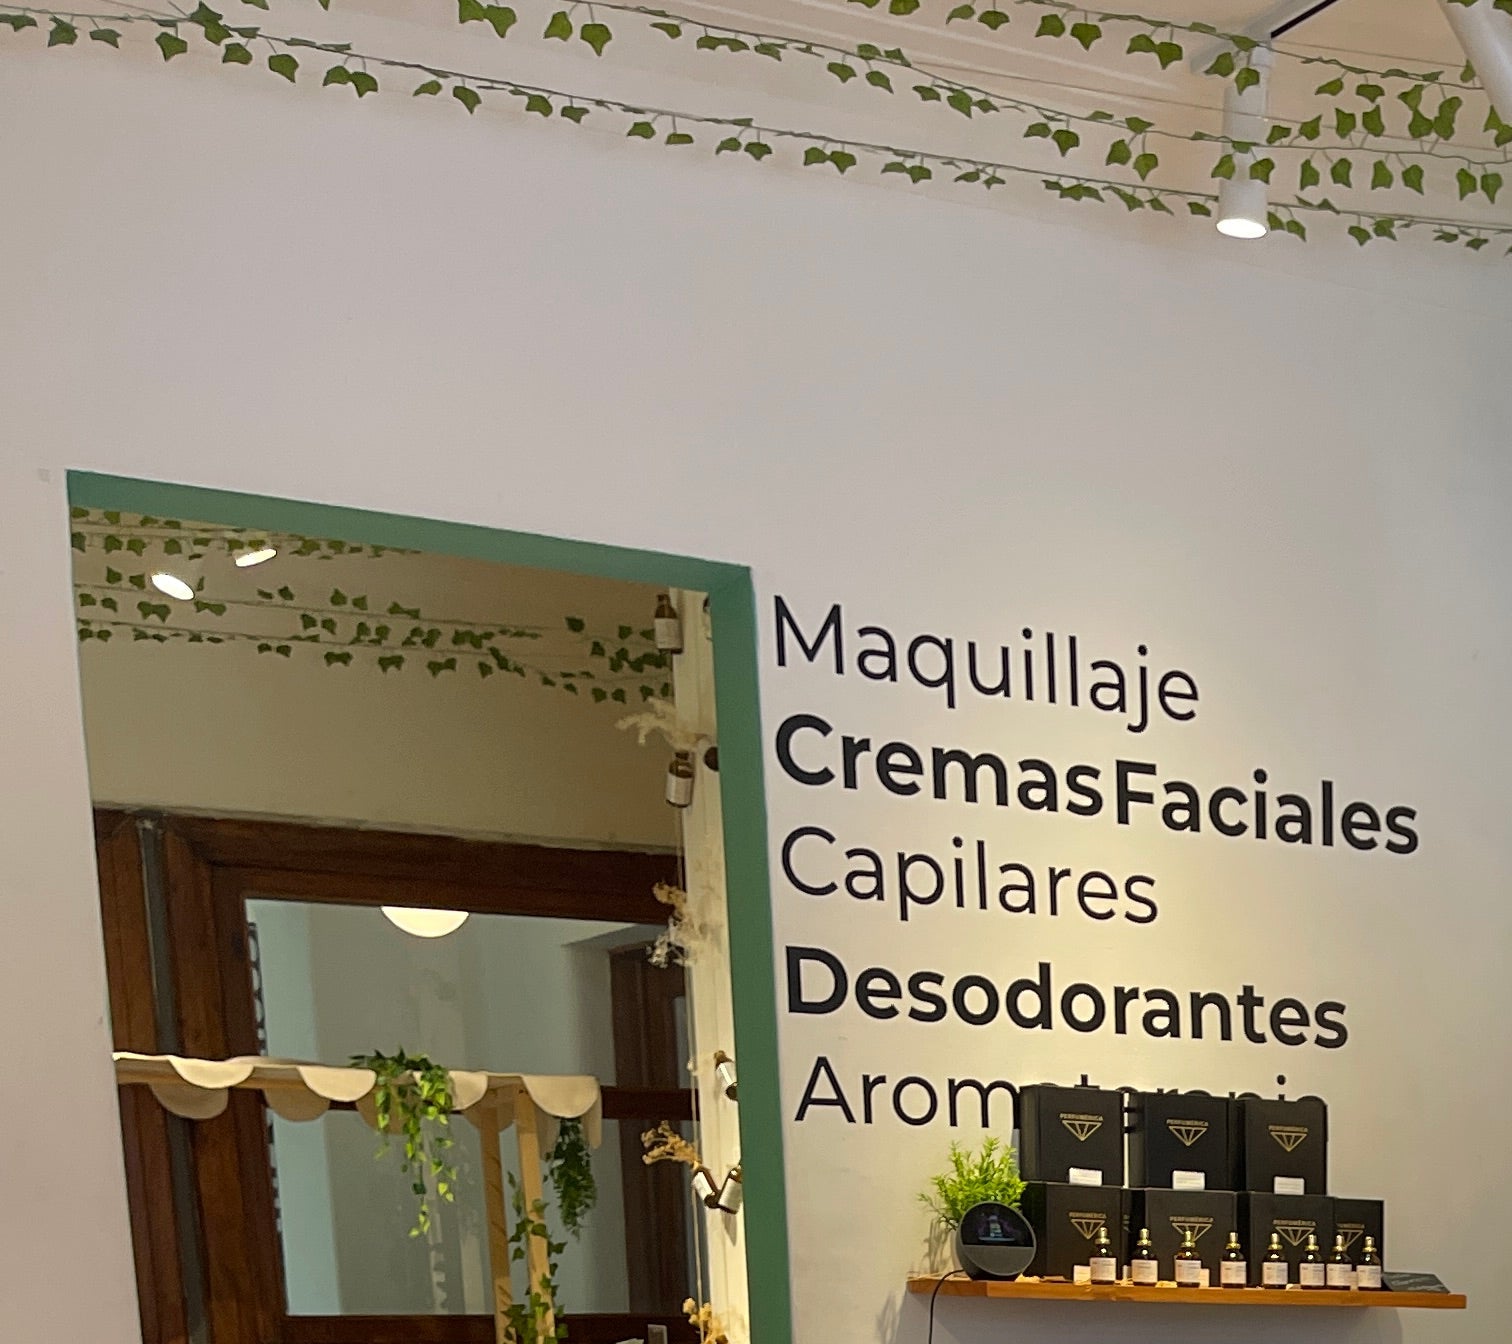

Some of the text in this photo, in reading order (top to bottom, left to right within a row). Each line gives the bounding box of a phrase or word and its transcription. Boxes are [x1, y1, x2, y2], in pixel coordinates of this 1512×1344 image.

[773, 594, 1201, 733] Maquillaje
[779, 825, 1160, 924] Capilares
[785, 944, 1350, 1050] Desodorantes
